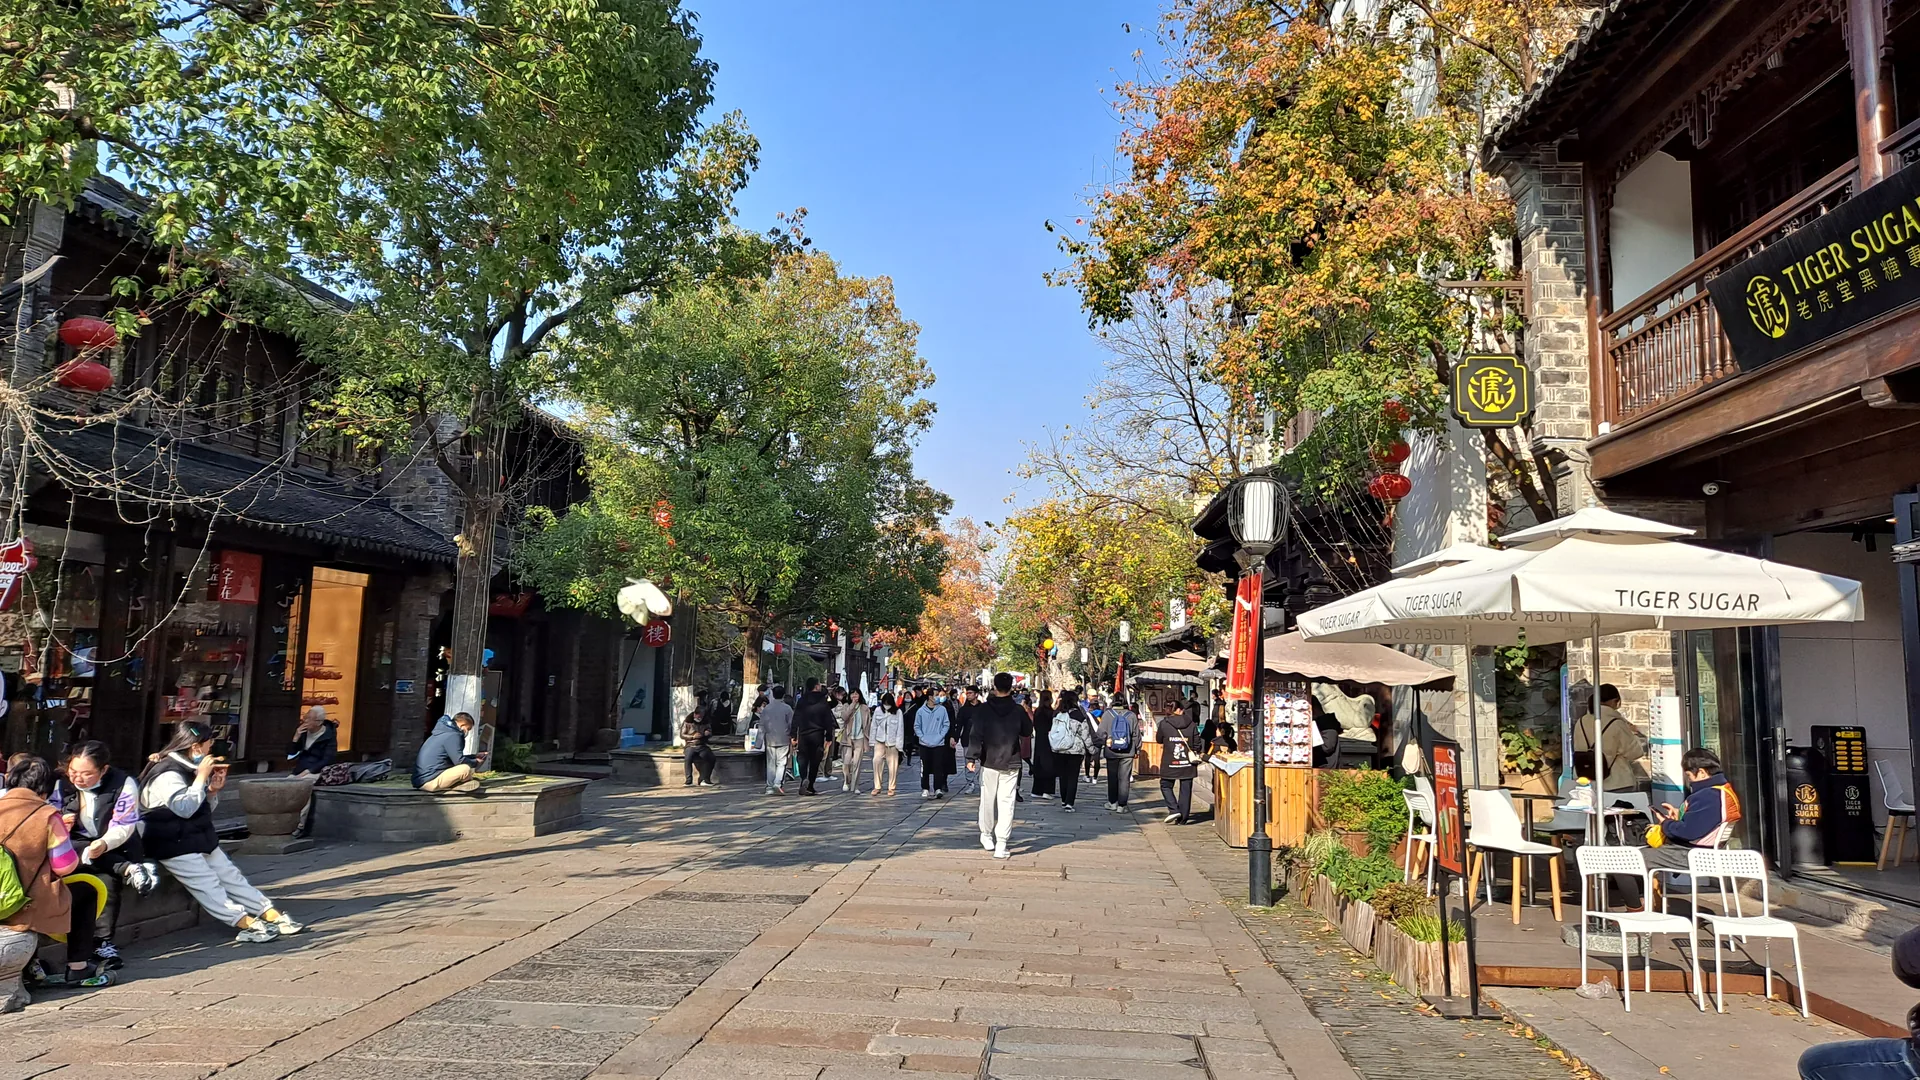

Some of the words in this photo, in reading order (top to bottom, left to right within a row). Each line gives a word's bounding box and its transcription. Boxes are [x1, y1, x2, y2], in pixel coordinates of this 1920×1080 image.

[1782, 242, 1852, 295] TIGER
[1850, 196, 1920, 264] SUGA
[1405, 594, 1430, 611] TIGER
[1431, 590, 1463, 609] SUGAR
[1615, 589, 1680, 609] TIGER
[1688, 592, 1760, 611] SUGAR
[1319, 615, 1338, 630] TIGER
[1338, 610, 1361, 627] SUGAR
[116, 800, 127, 813] 9
